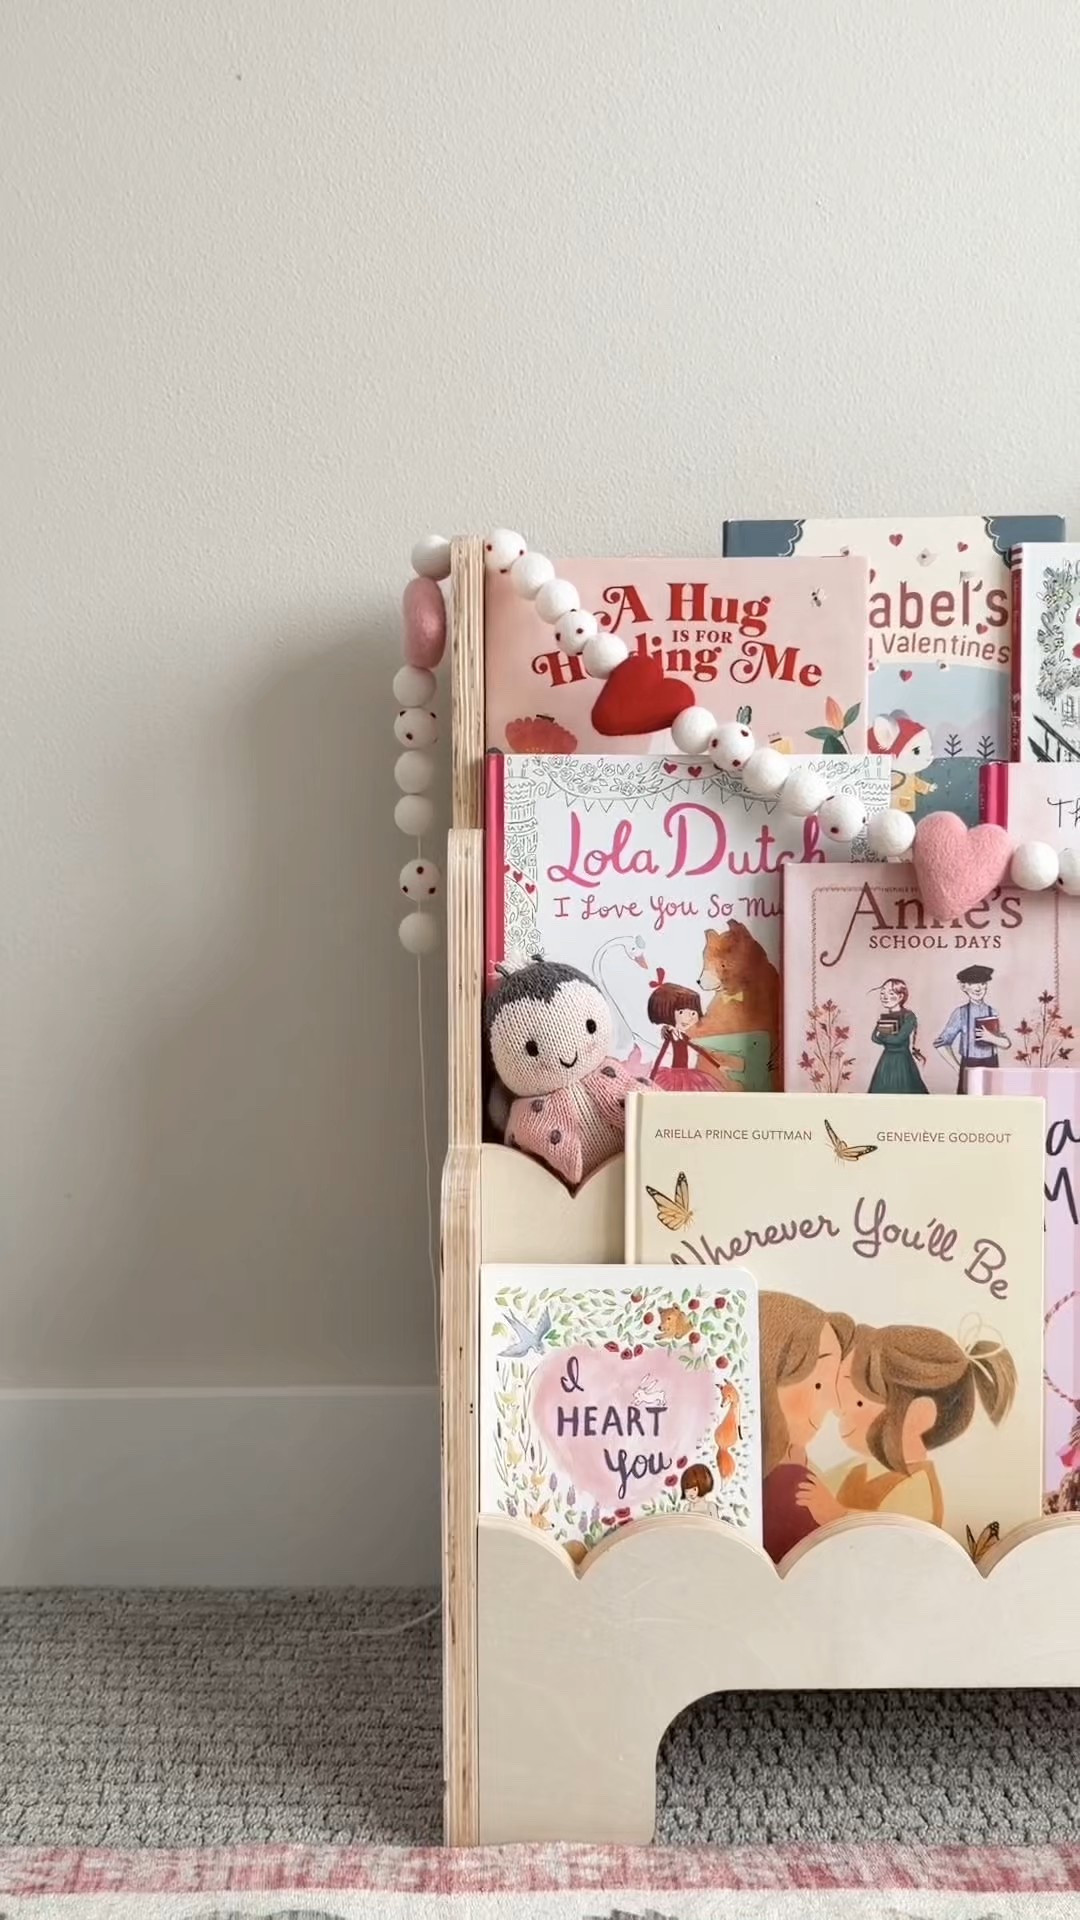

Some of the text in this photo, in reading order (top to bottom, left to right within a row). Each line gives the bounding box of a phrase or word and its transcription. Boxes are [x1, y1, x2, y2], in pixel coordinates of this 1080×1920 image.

[593, 583, 771, 638] A Hug
[672, 630, 733, 644] IS FOR
[882, 632, 1011, 664] Valentines
[730, 640, 823, 687] Me
[547, 811, 660, 888] Lola
[554, 896, 571, 918] I
[581, 894, 643, 919] Love
[650, 896, 699, 931] You
[707, 894, 734, 918] So
[868, 934, 1002, 949] SCHOOL DAYS
[654, 1128, 813, 1142] ARIELLA PRINCE GUTTMAN
[876, 1130, 1012, 1144] GENEVIÈVE GODBOUT
[852, 1196, 958, 1262] You'll
[964, 1238, 1009, 1300] Be
[560, 1356, 584, 1393] I
[557, 1405, 668, 1437] HEART
